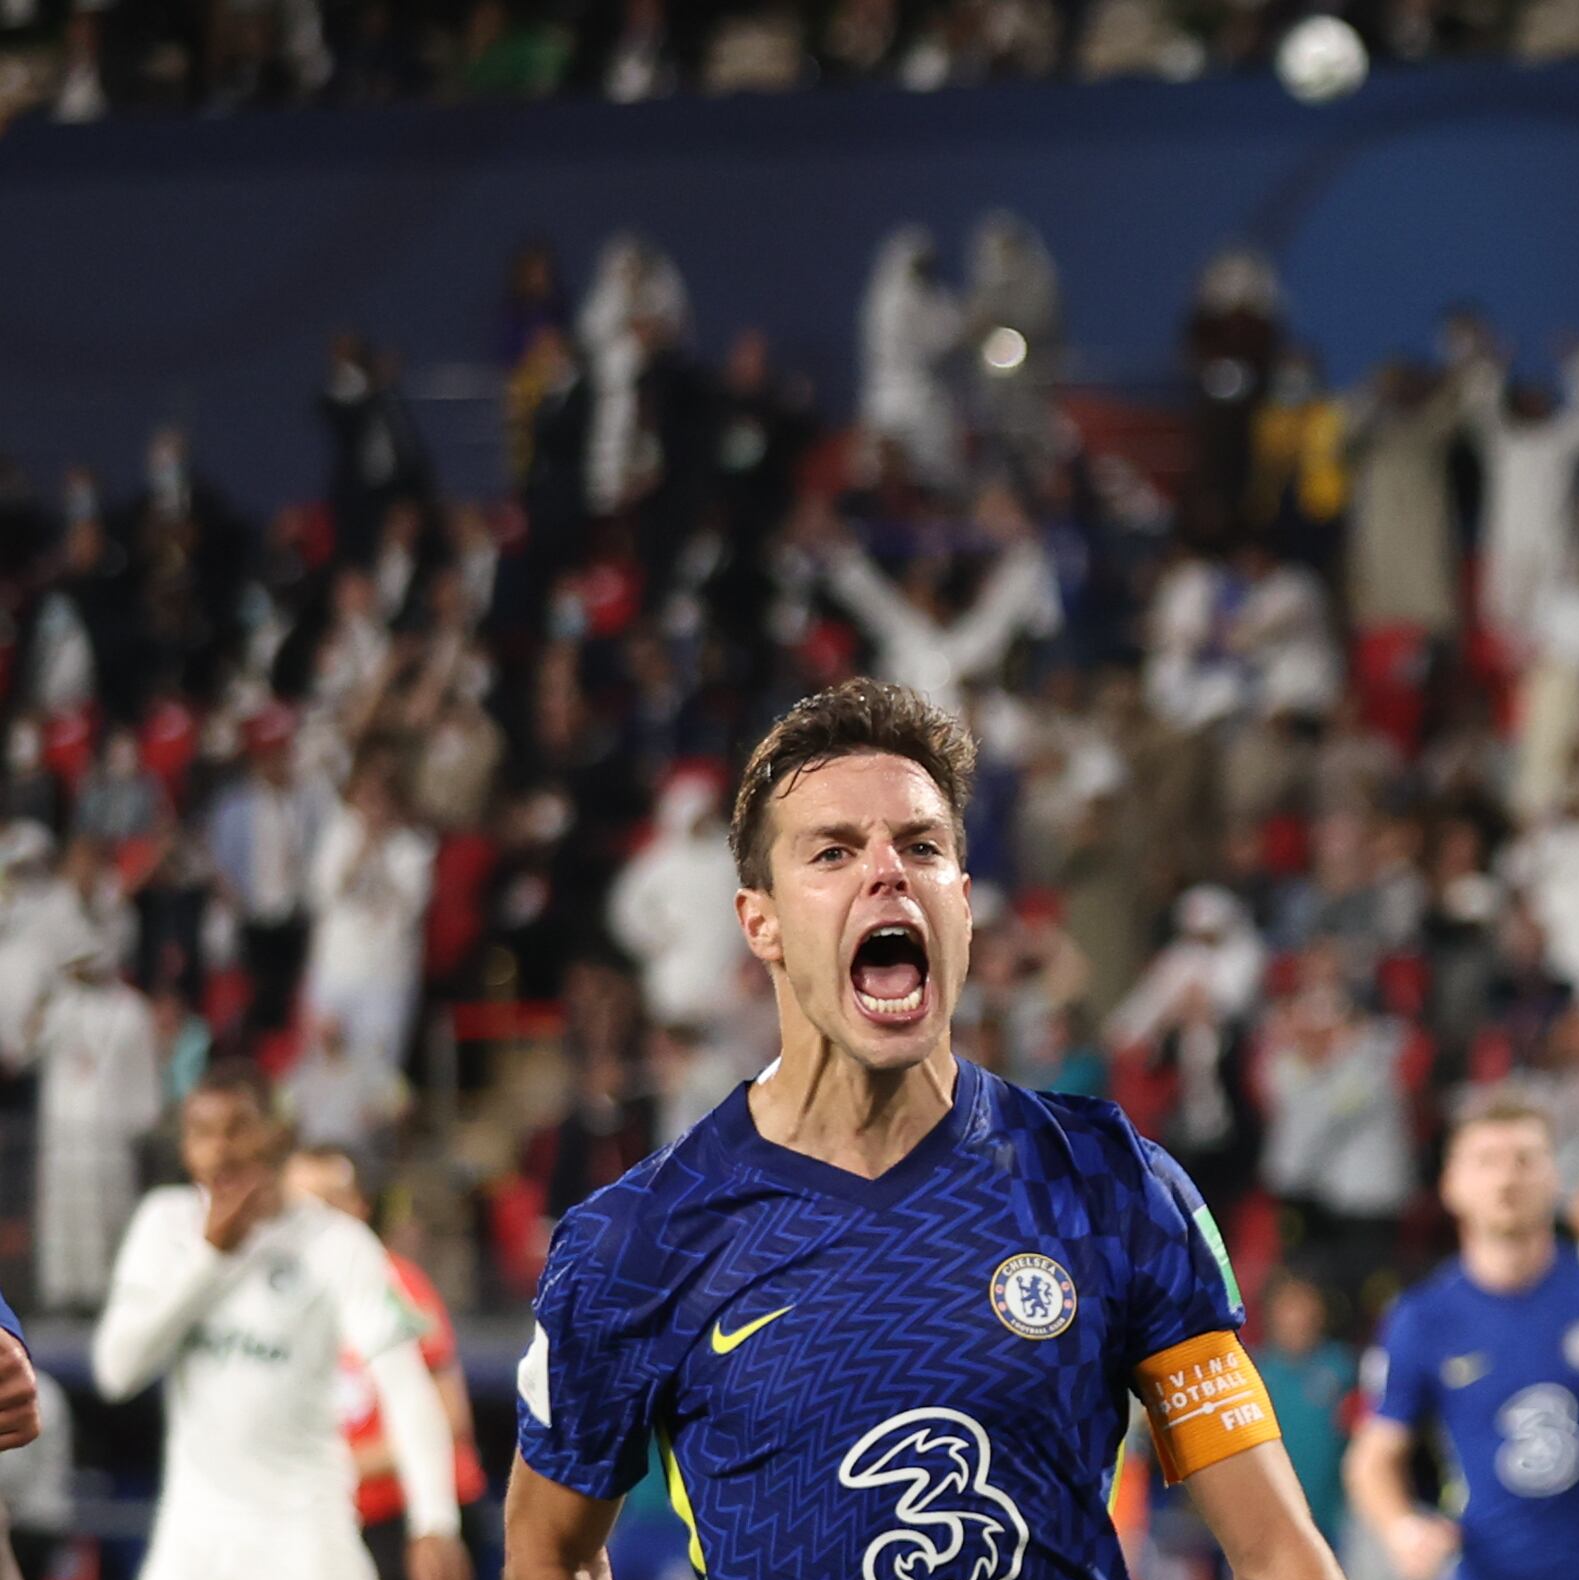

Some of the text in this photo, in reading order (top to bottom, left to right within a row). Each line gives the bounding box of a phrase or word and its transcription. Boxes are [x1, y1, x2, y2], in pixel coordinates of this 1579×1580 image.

[1002, 1257, 1056, 1276] CHELSEA
[1155, 1352, 1239, 1396] IVING
[1158, 1371, 1248, 1414] OOTBALL
[1220, 1402, 1264, 1431] FIFA
